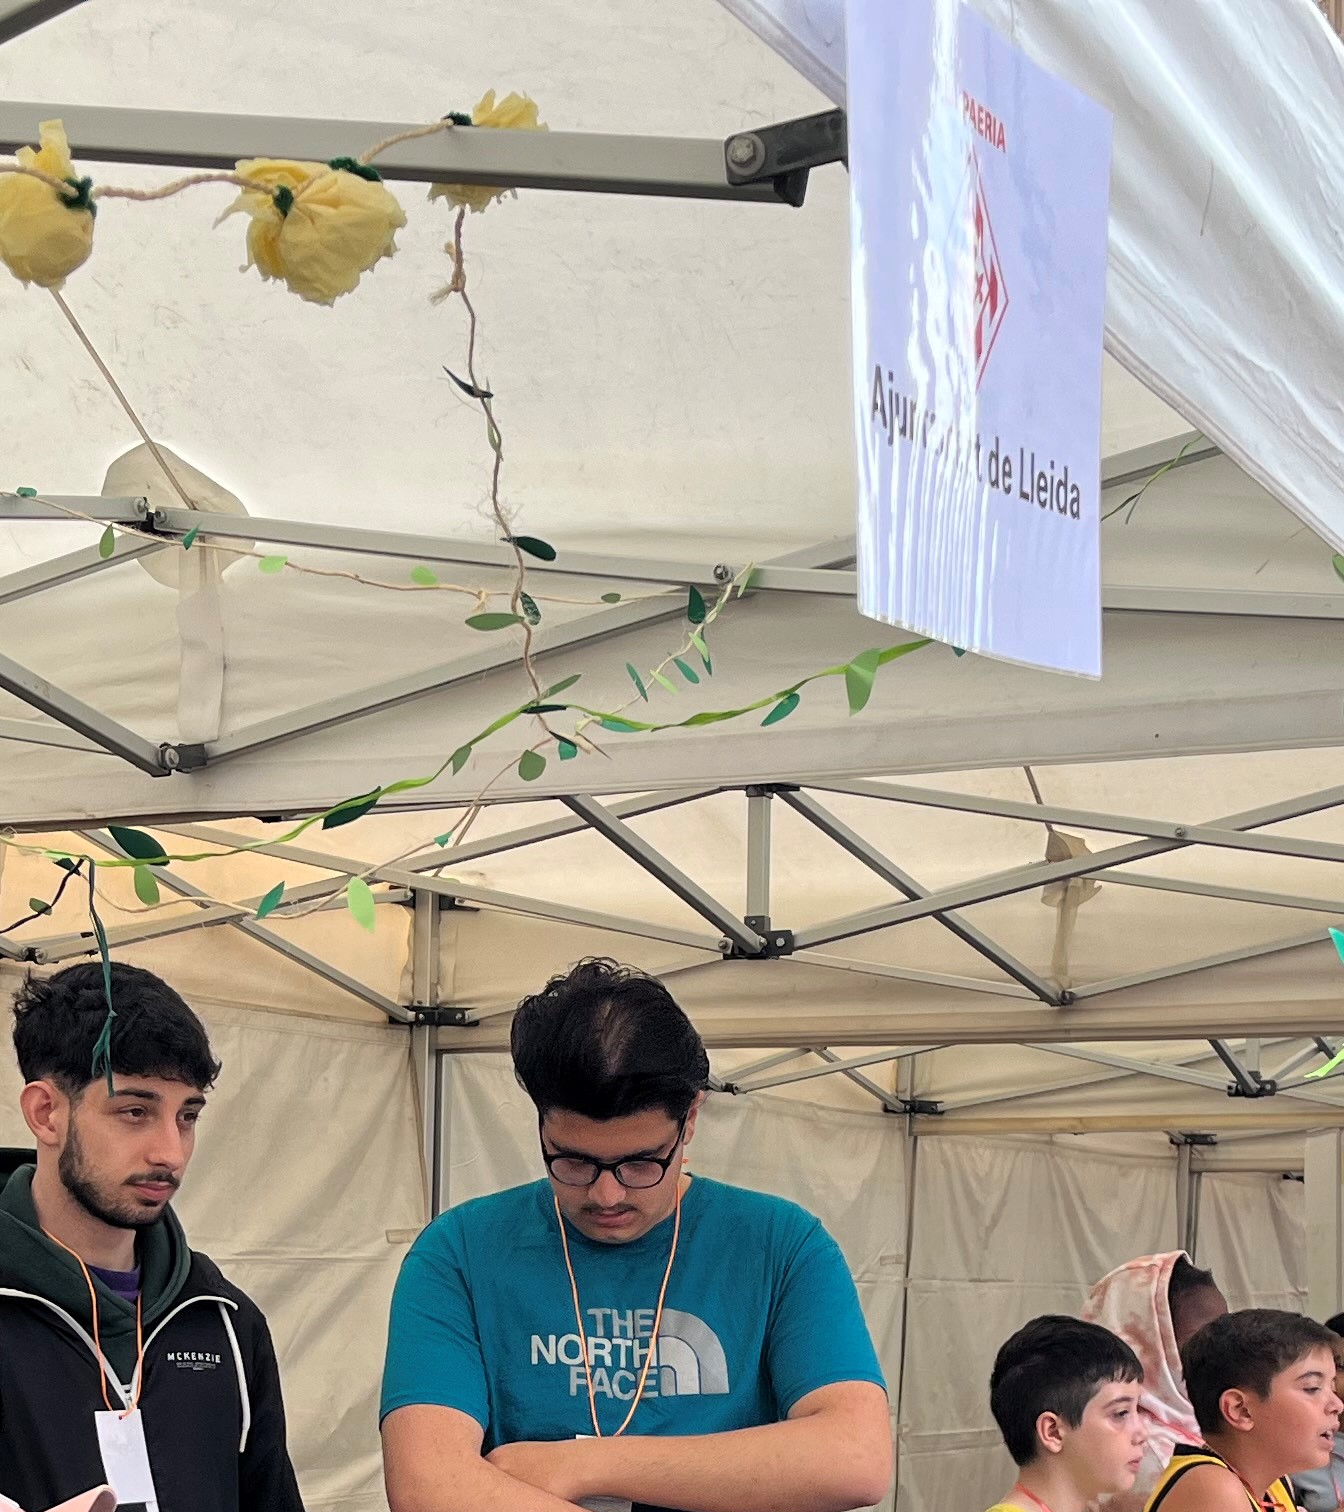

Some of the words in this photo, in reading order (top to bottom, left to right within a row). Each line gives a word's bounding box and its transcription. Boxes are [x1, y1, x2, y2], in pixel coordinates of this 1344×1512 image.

[988, 436, 1012, 495] de
[1019, 447, 1080, 520] Lleida
[587, 1308, 656, 1337] THE
[531, 1334, 657, 1368] NORTH
[570, 1366, 658, 1400] FACE
